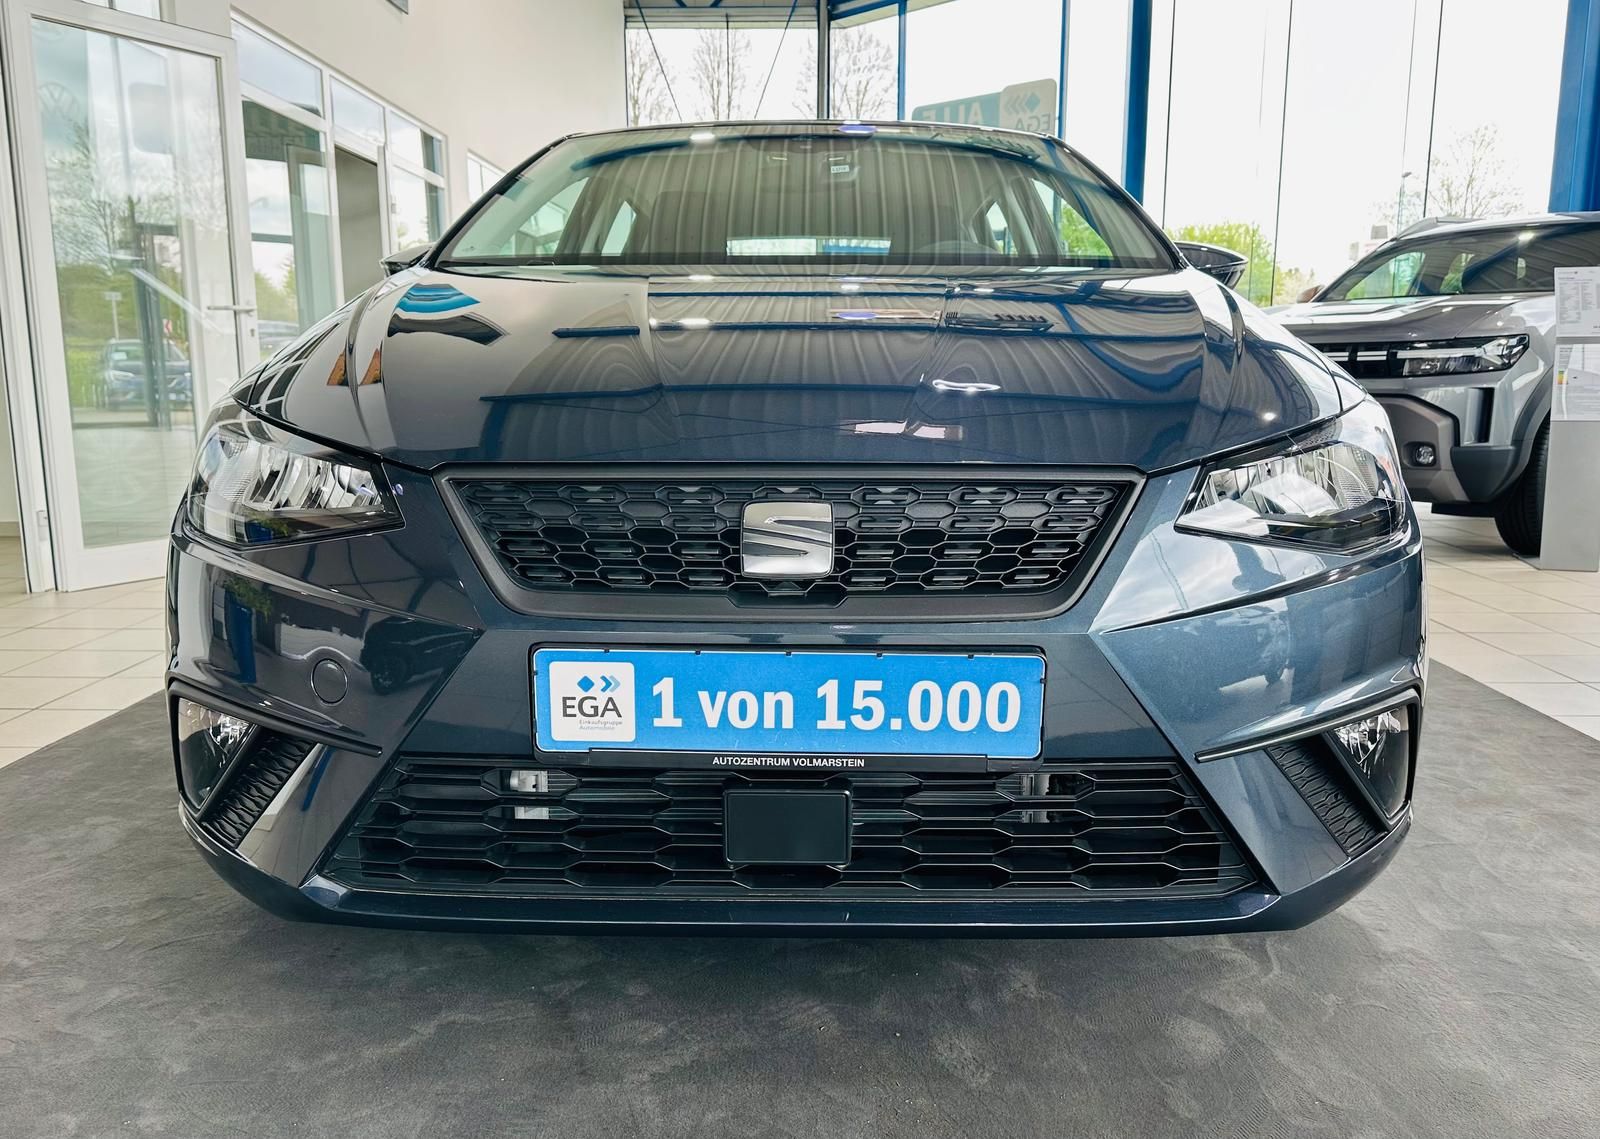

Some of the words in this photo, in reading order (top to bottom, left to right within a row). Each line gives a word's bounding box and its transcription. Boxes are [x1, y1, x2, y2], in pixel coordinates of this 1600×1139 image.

[562, 696, 622, 718] EGA
[652, 677, 683, 728] 1
[697, 690, 794, 729] von
[816, 679, 1021, 733] 15.000
[712, 757, 790, 767] AUTOZENTRUM
[792, 758, 865, 767] VOLMARSTEIN
